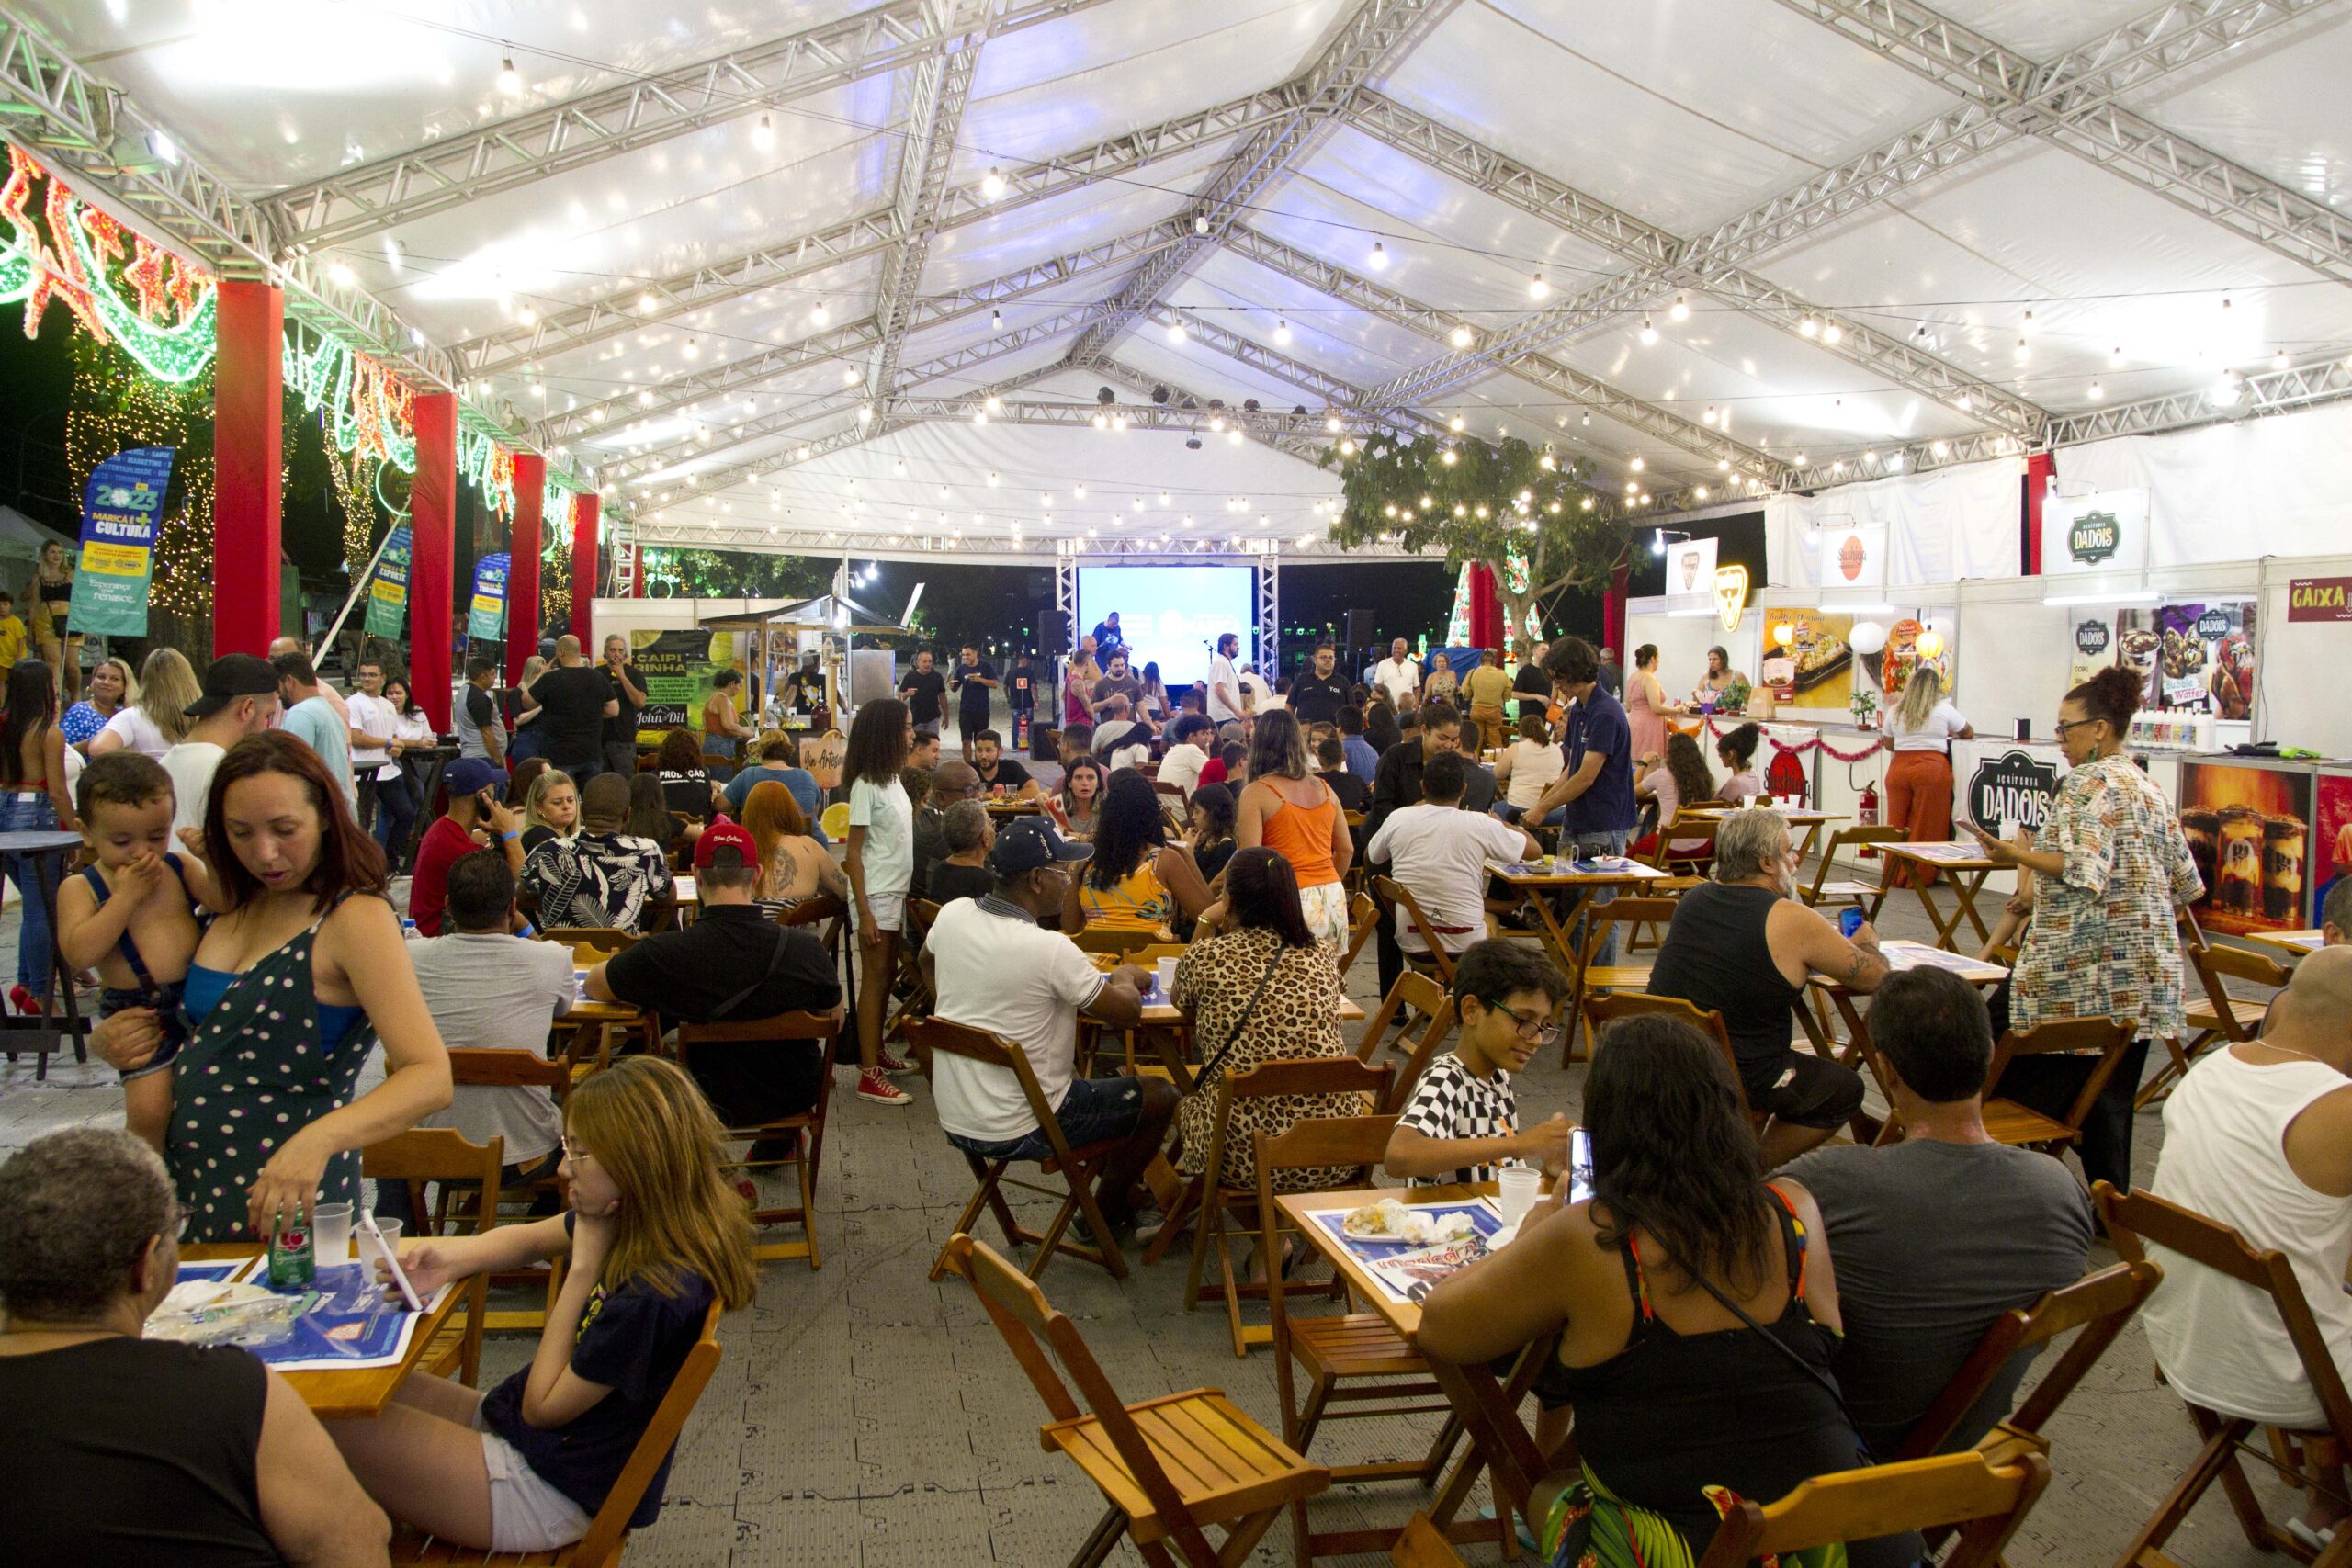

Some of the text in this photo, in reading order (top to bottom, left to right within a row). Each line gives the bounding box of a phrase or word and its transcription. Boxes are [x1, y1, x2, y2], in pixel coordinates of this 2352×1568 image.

[95, 521, 151, 538] CULTURA
[2075, 527, 2113, 550] DADOIS
[379, 567, 407, 583] ESPORTE
[2292, 585, 2346, 609] CAIXA
[2199, 619, 2227, 633] DADOIS
[2079, 631, 2105, 646] DADOIS
[636, 653, 682, 662] CAIPI
[636, 711, 685, 726] John Dil
[1996, 773, 2038, 787] AÇAÍTERIA
[1982, 784, 2052, 828] DADOIS
